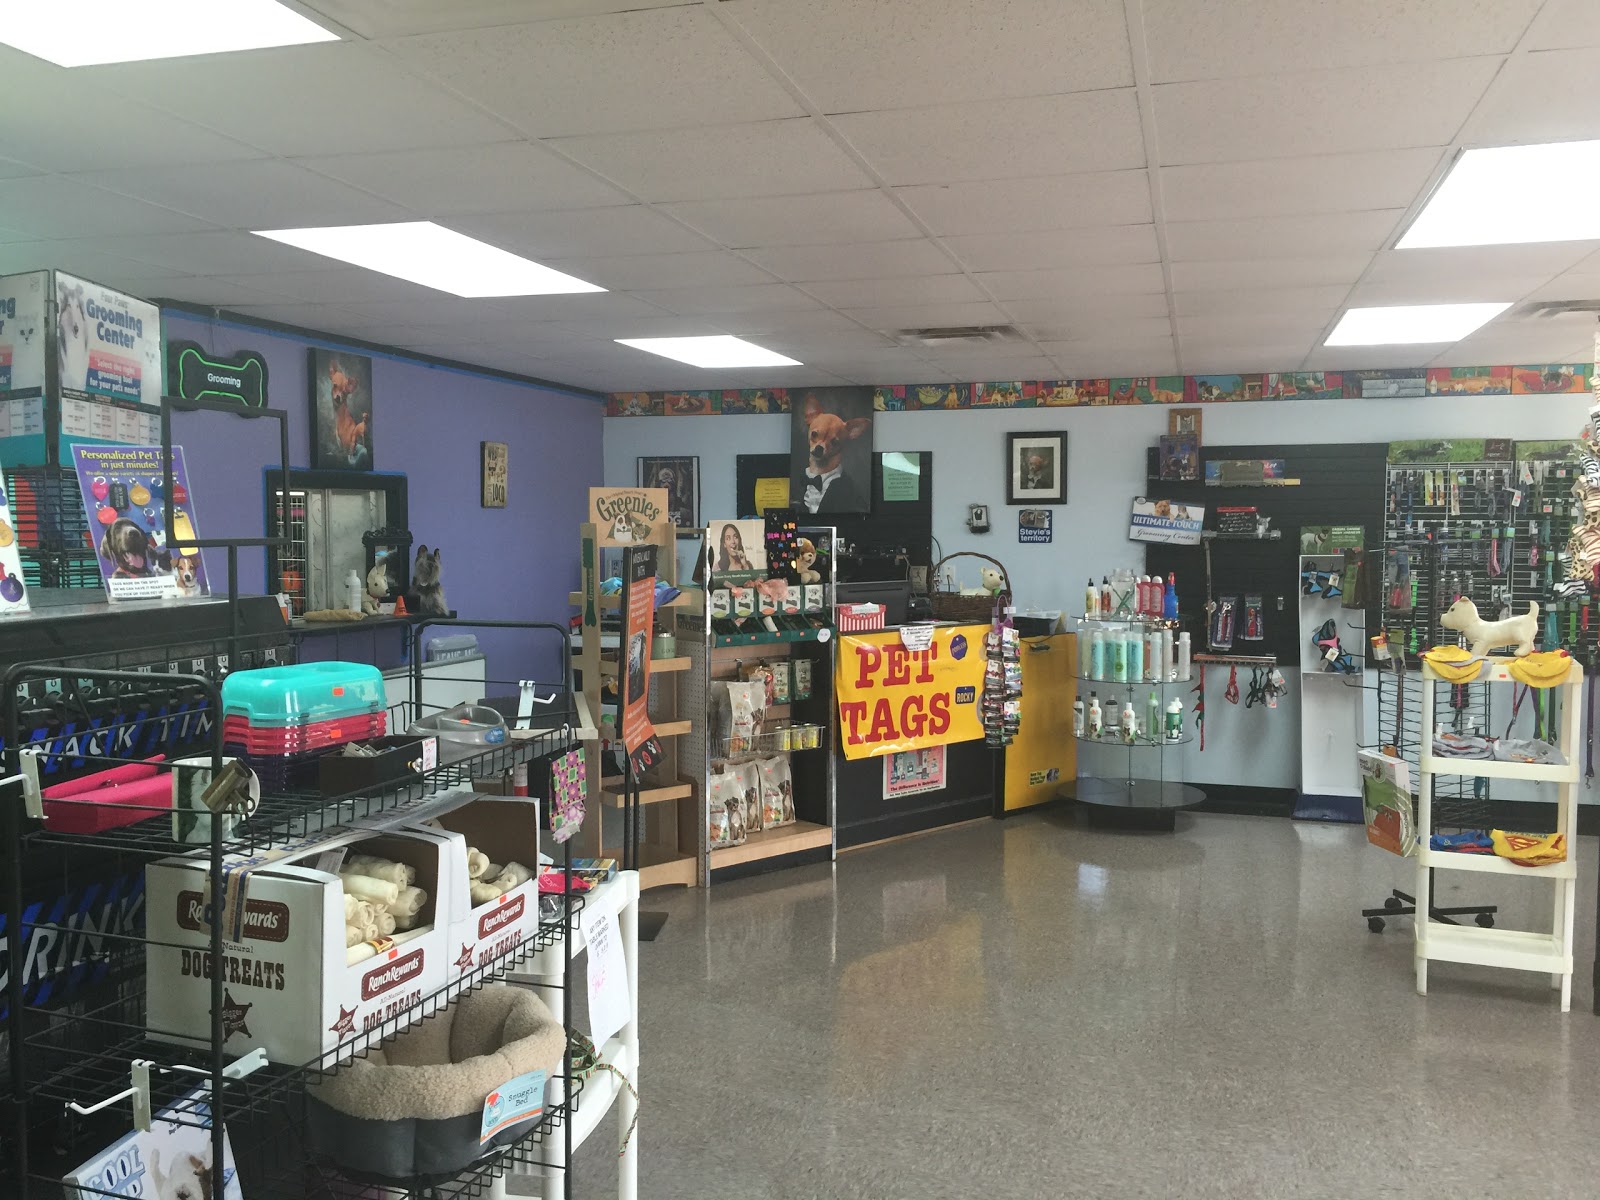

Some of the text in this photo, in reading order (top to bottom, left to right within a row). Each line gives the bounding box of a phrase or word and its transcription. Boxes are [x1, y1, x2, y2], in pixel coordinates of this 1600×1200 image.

[86, 298, 142, 338] Grooming
[97, 322, 135, 349] Center
[90, 377, 98, 387] for
[207, 373, 241, 388] Grooming
[80, 450, 175, 461] Personalized Pet Ts
[110, 461, 124, 469] just
[126, 461, 159, 469] minutes!
[596, 494, 660, 521] Greenies
[1133, 515, 1199, 530] ULTIMATE TOUCH
[1137, 528, 1195, 541] Grooming Center
[855, 641, 937, 688] PET
[957, 692, 974, 702] ROCKY
[840, 692, 950, 745] TAGS
[20, 724, 137, 765] NACK
[483, 902, 521, 931] RanchRewards
[22, 892, 145, 985] RINK
[479, 928, 521, 966] DOG TREATS
[181, 950, 284, 990] DOG TREATS
[368, 957, 419, 992] RanchRewards
[363, 989, 421, 1030] DOG TREATS
[508, 1086, 538, 1102] Snuggle
[515, 1097, 528, 1107] Bed
